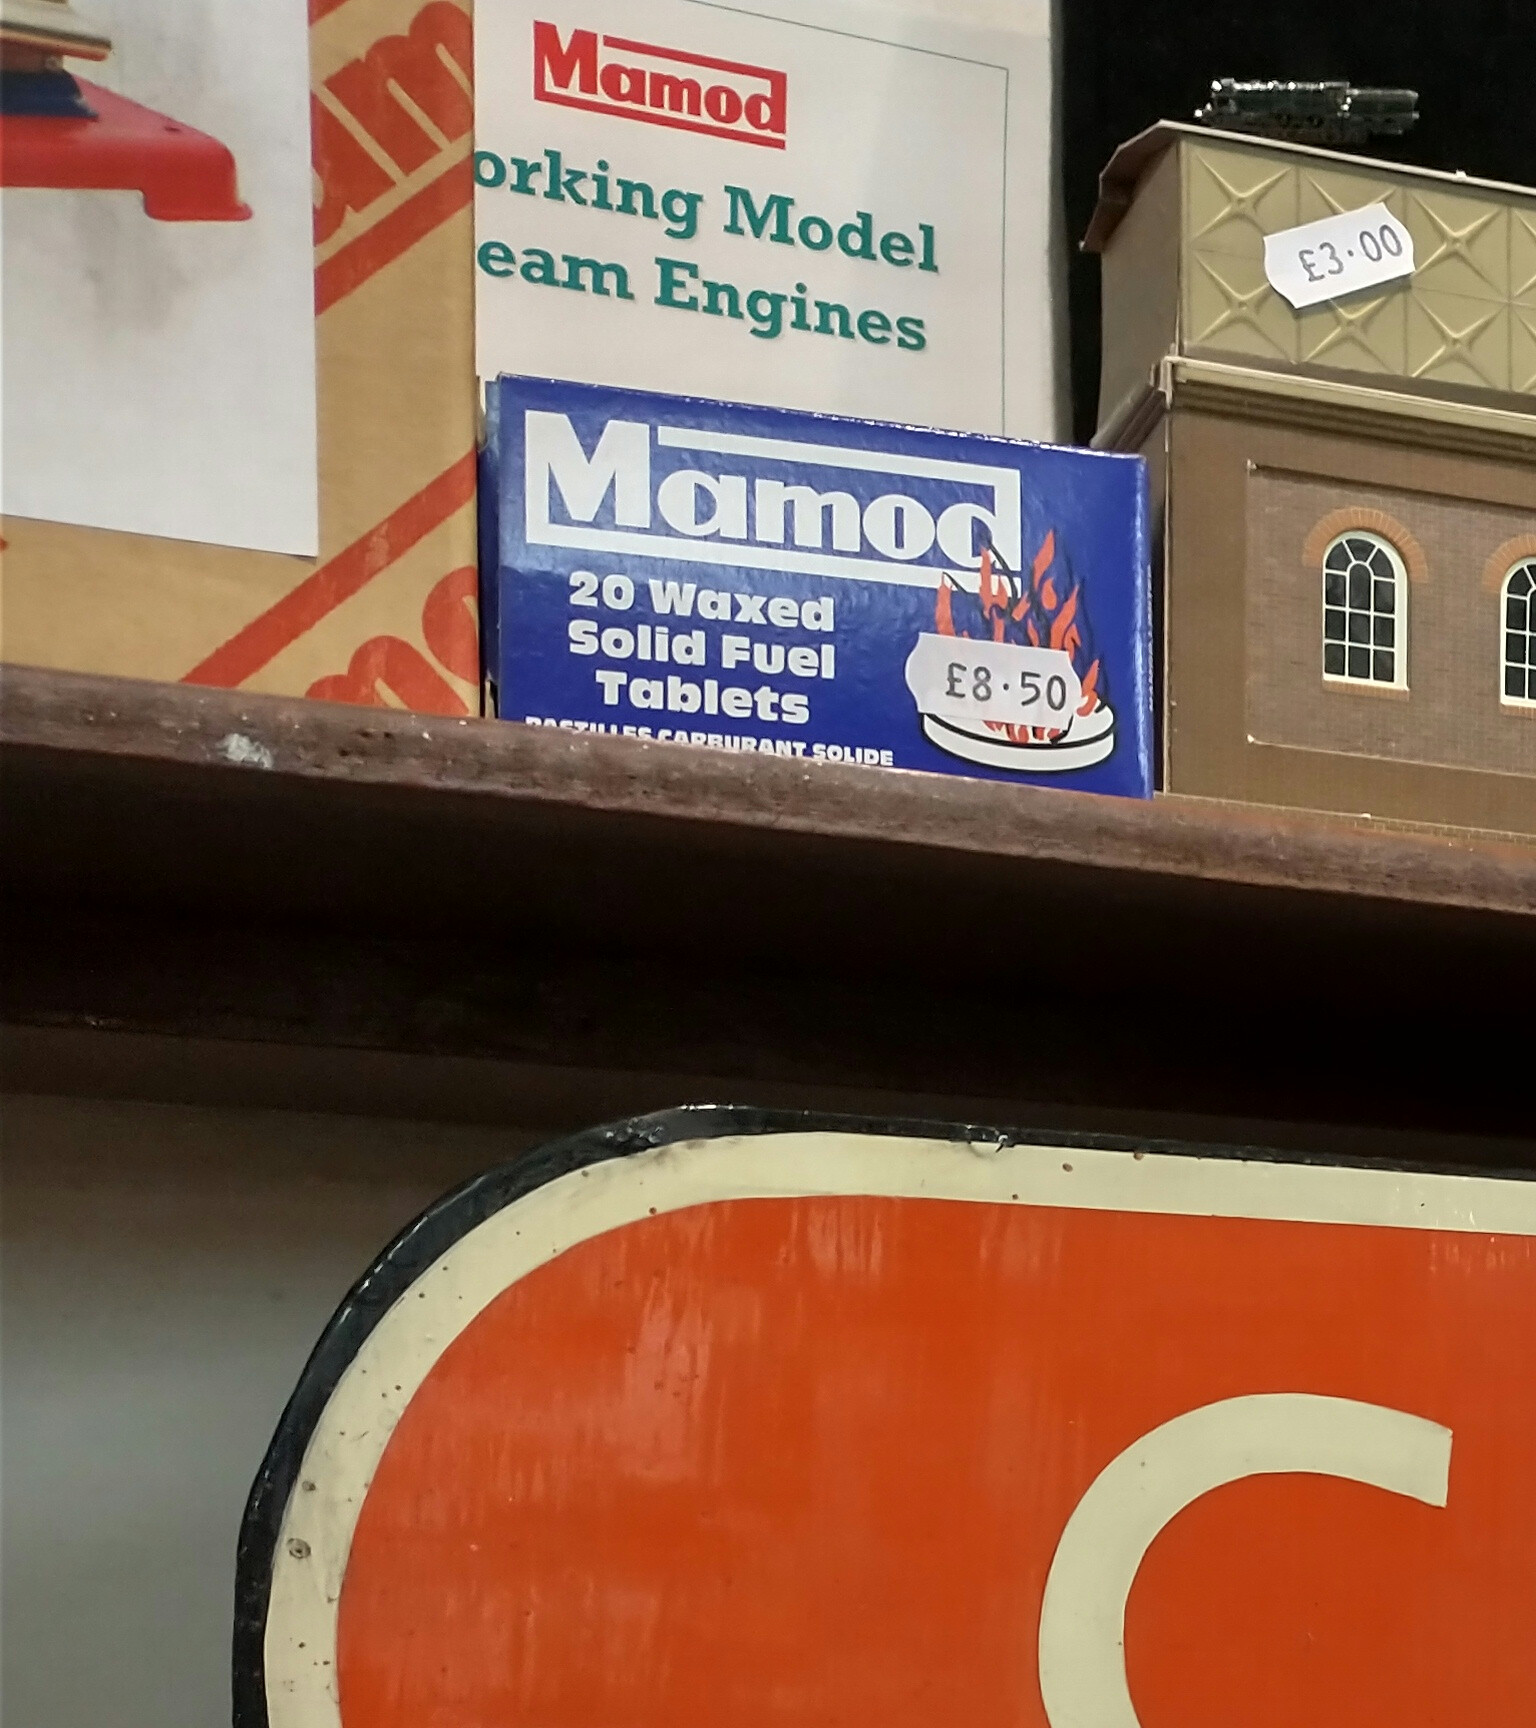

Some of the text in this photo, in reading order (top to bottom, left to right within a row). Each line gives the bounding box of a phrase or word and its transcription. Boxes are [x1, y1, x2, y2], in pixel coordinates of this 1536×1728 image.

[534, 20, 787, 148] Mamod
[474, 148, 939, 273] orking Model
[477, 238, 928, 352] eam Engines
[525, 410, 1021, 592] Mamod
[569, 571, 835, 631] 20 Waxed
[568, 620, 835, 679] Solid Fuel
[596, 669, 810, 725] Tablets
[812, 743, 894, 767] SOLIDE
